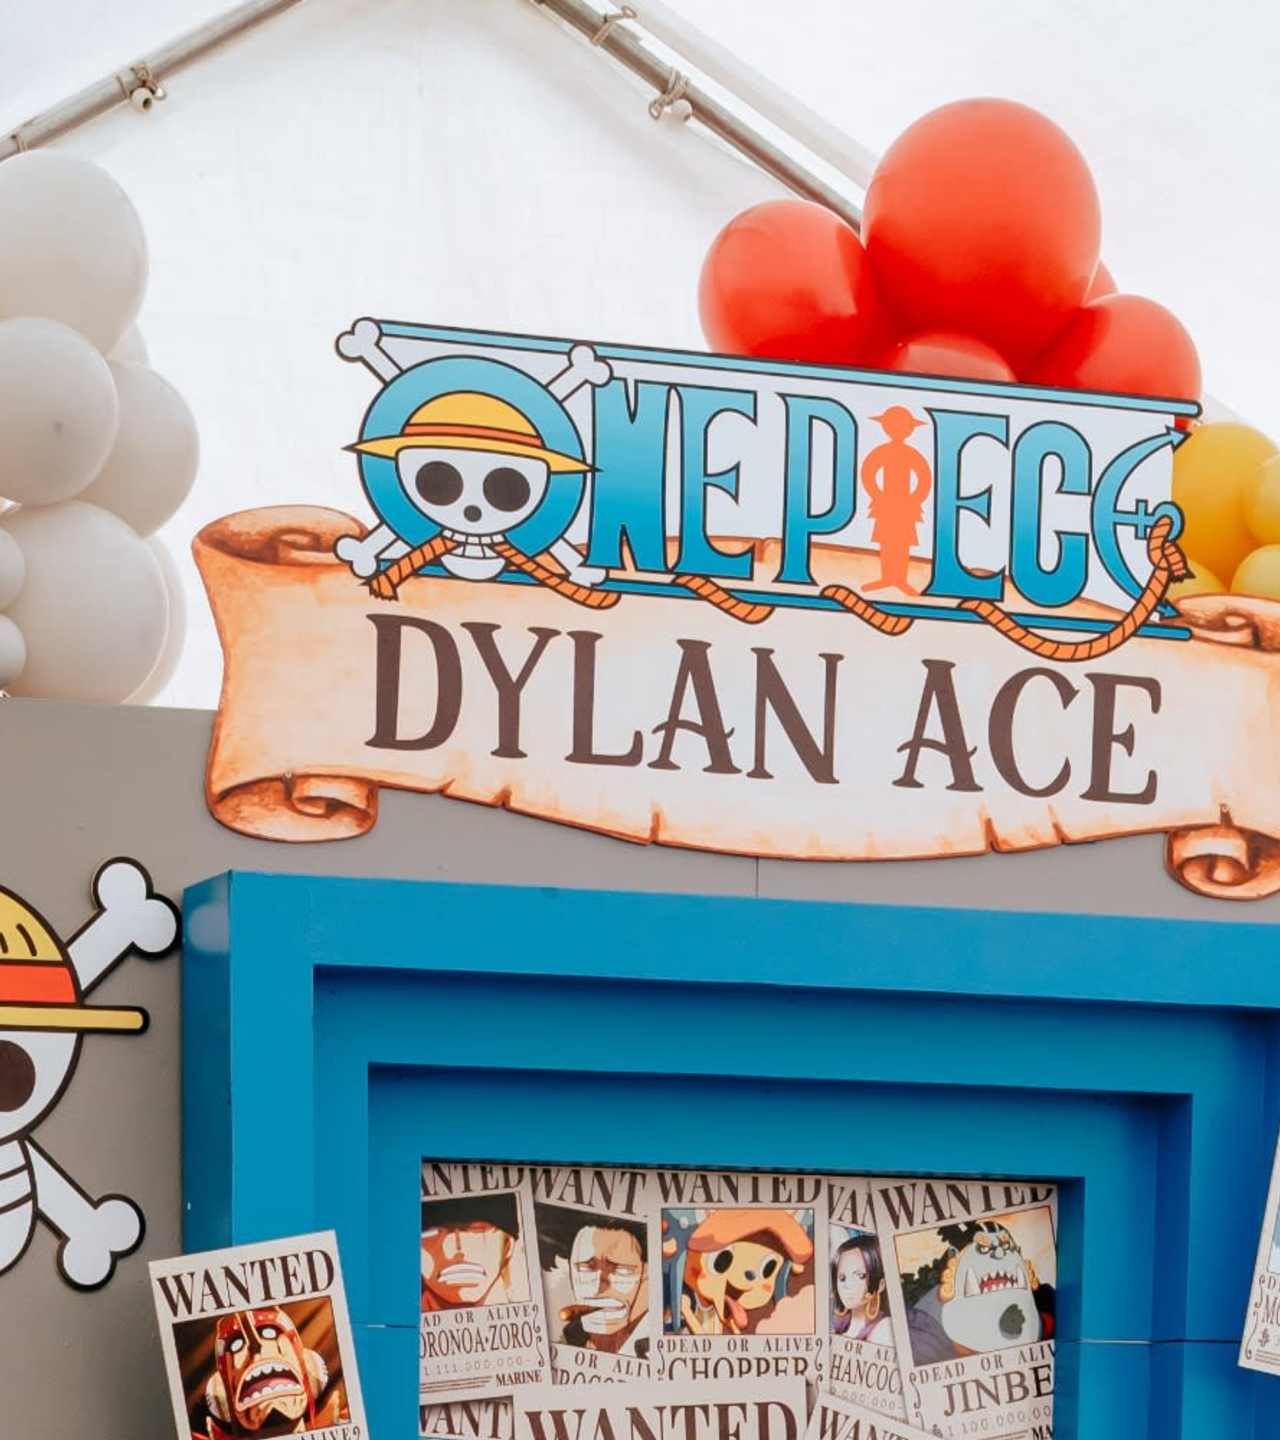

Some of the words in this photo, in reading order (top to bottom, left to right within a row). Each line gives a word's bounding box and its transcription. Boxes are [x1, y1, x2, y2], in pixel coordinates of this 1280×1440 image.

[366, 612, 845, 786] DYLAN
[894, 659, 1164, 806] ACE
[421, 1165, 524, 1197] ANTED
[529, 1166, 647, 1217] WANT
[657, 1171, 820, 1203] WANTED
[880, 1182, 1054, 1231] WANTED
[156, 1249, 335, 1318] WANTED
[455, 1311, 474, 1324] OR
[487, 1305, 531, 1321] ALIVE
[574, 1351, 598, 1369] OR
[666, 1338, 712, 1353] DEAD
[727, 1338, 749, 1352] OR
[764, 1337, 814, 1352] ALIVE
[496, 1370, 543, 1387] MARINE
[920, 1361, 965, 1384] DEAD
[980, 1354, 1004, 1372] OR
